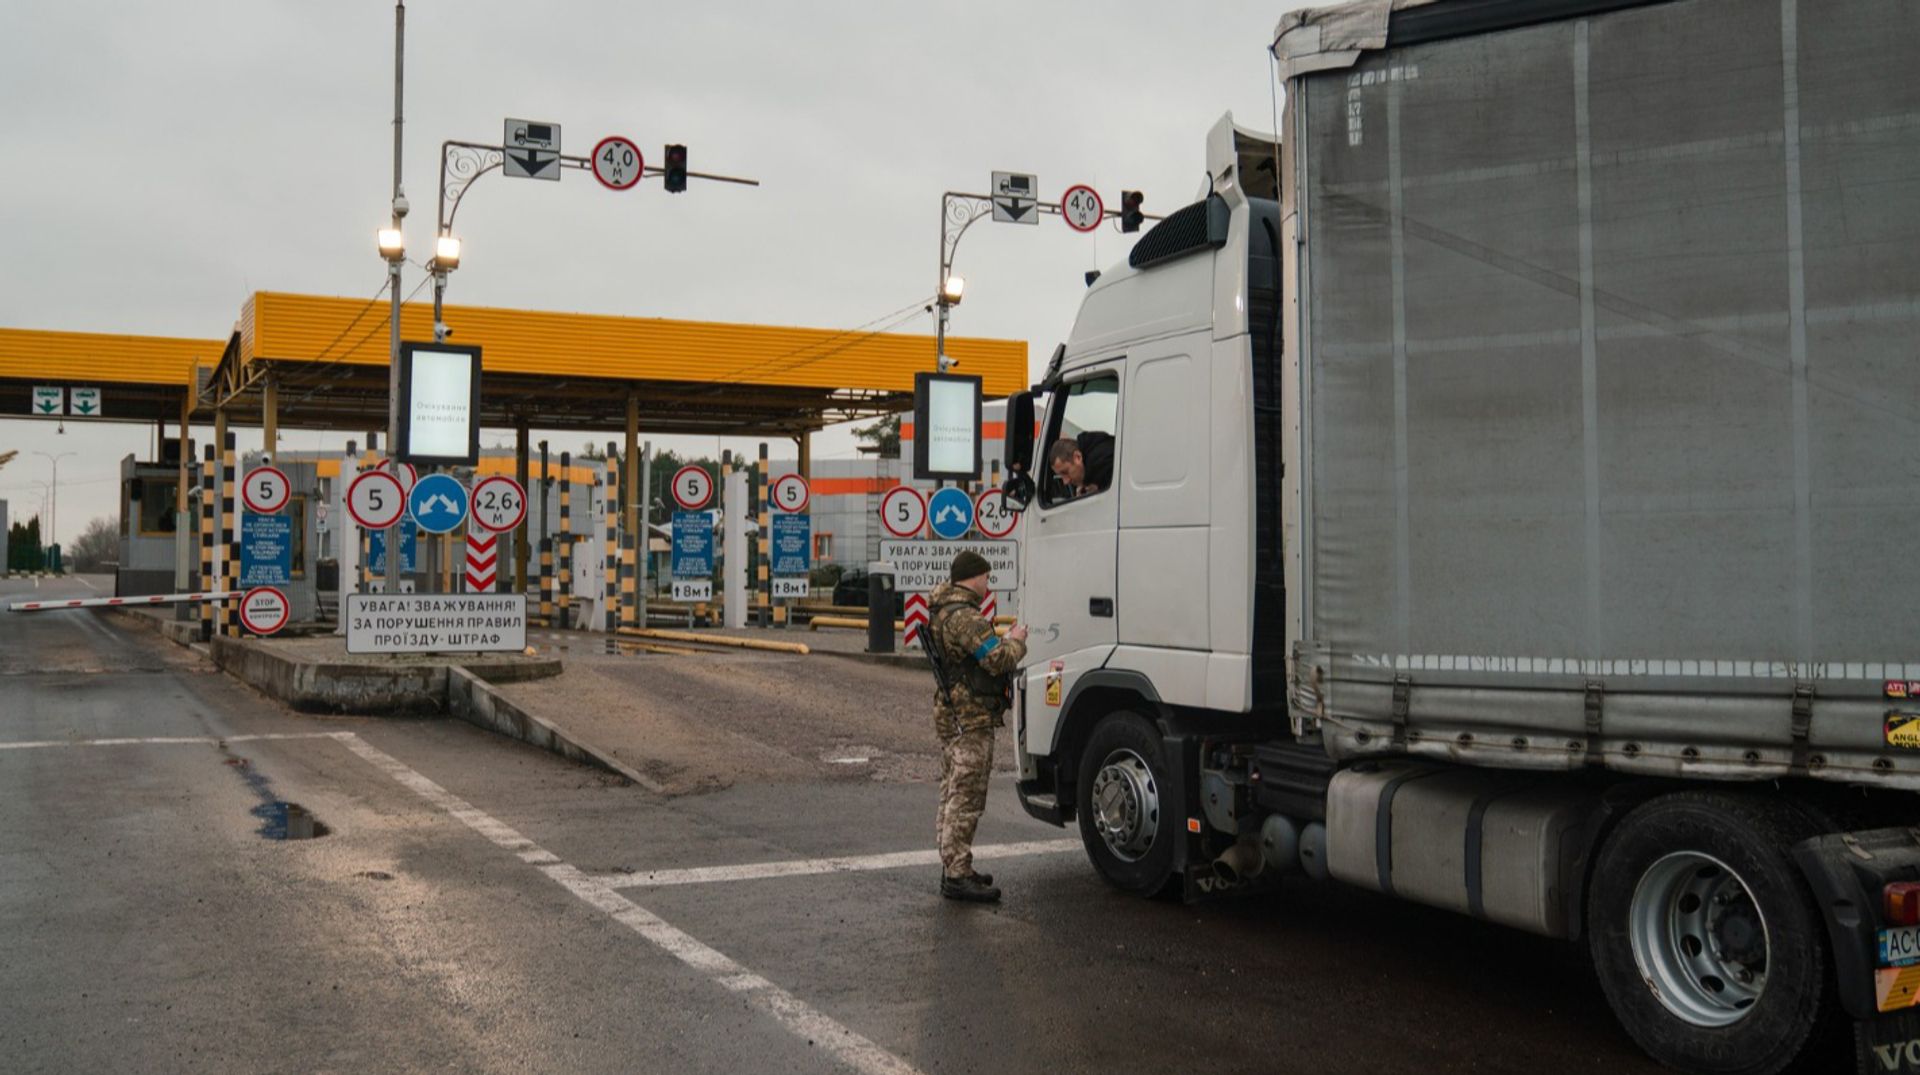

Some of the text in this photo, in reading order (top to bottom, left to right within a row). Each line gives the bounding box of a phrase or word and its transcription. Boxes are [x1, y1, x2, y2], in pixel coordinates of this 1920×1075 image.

[602, 147, 633, 168] 4,0
[1070, 195, 1095, 212] 4,0
[259, 481, 273, 500] 5
[687, 479, 699, 497] 5
[786, 486, 797, 502] 5
[368, 489, 383, 511] 5
[484, 491, 512, 511] 2,6
[897, 502, 910, 522] 5
[889, 546, 928, 556] УВАГА!
[360, 600, 516, 612] УВАГА! ЗВАЖУВАННЯ!
[354, 617, 522, 629] ЗА ПОРУШЕННЯ ПРАВИЛ
[448, 633, 501, 645] ШТРАФ
[1046, 622, 1060, 643] 5
[1893, 733, 1920, 742] ANGL
[1873, 1039, 1920, 1071] VO
